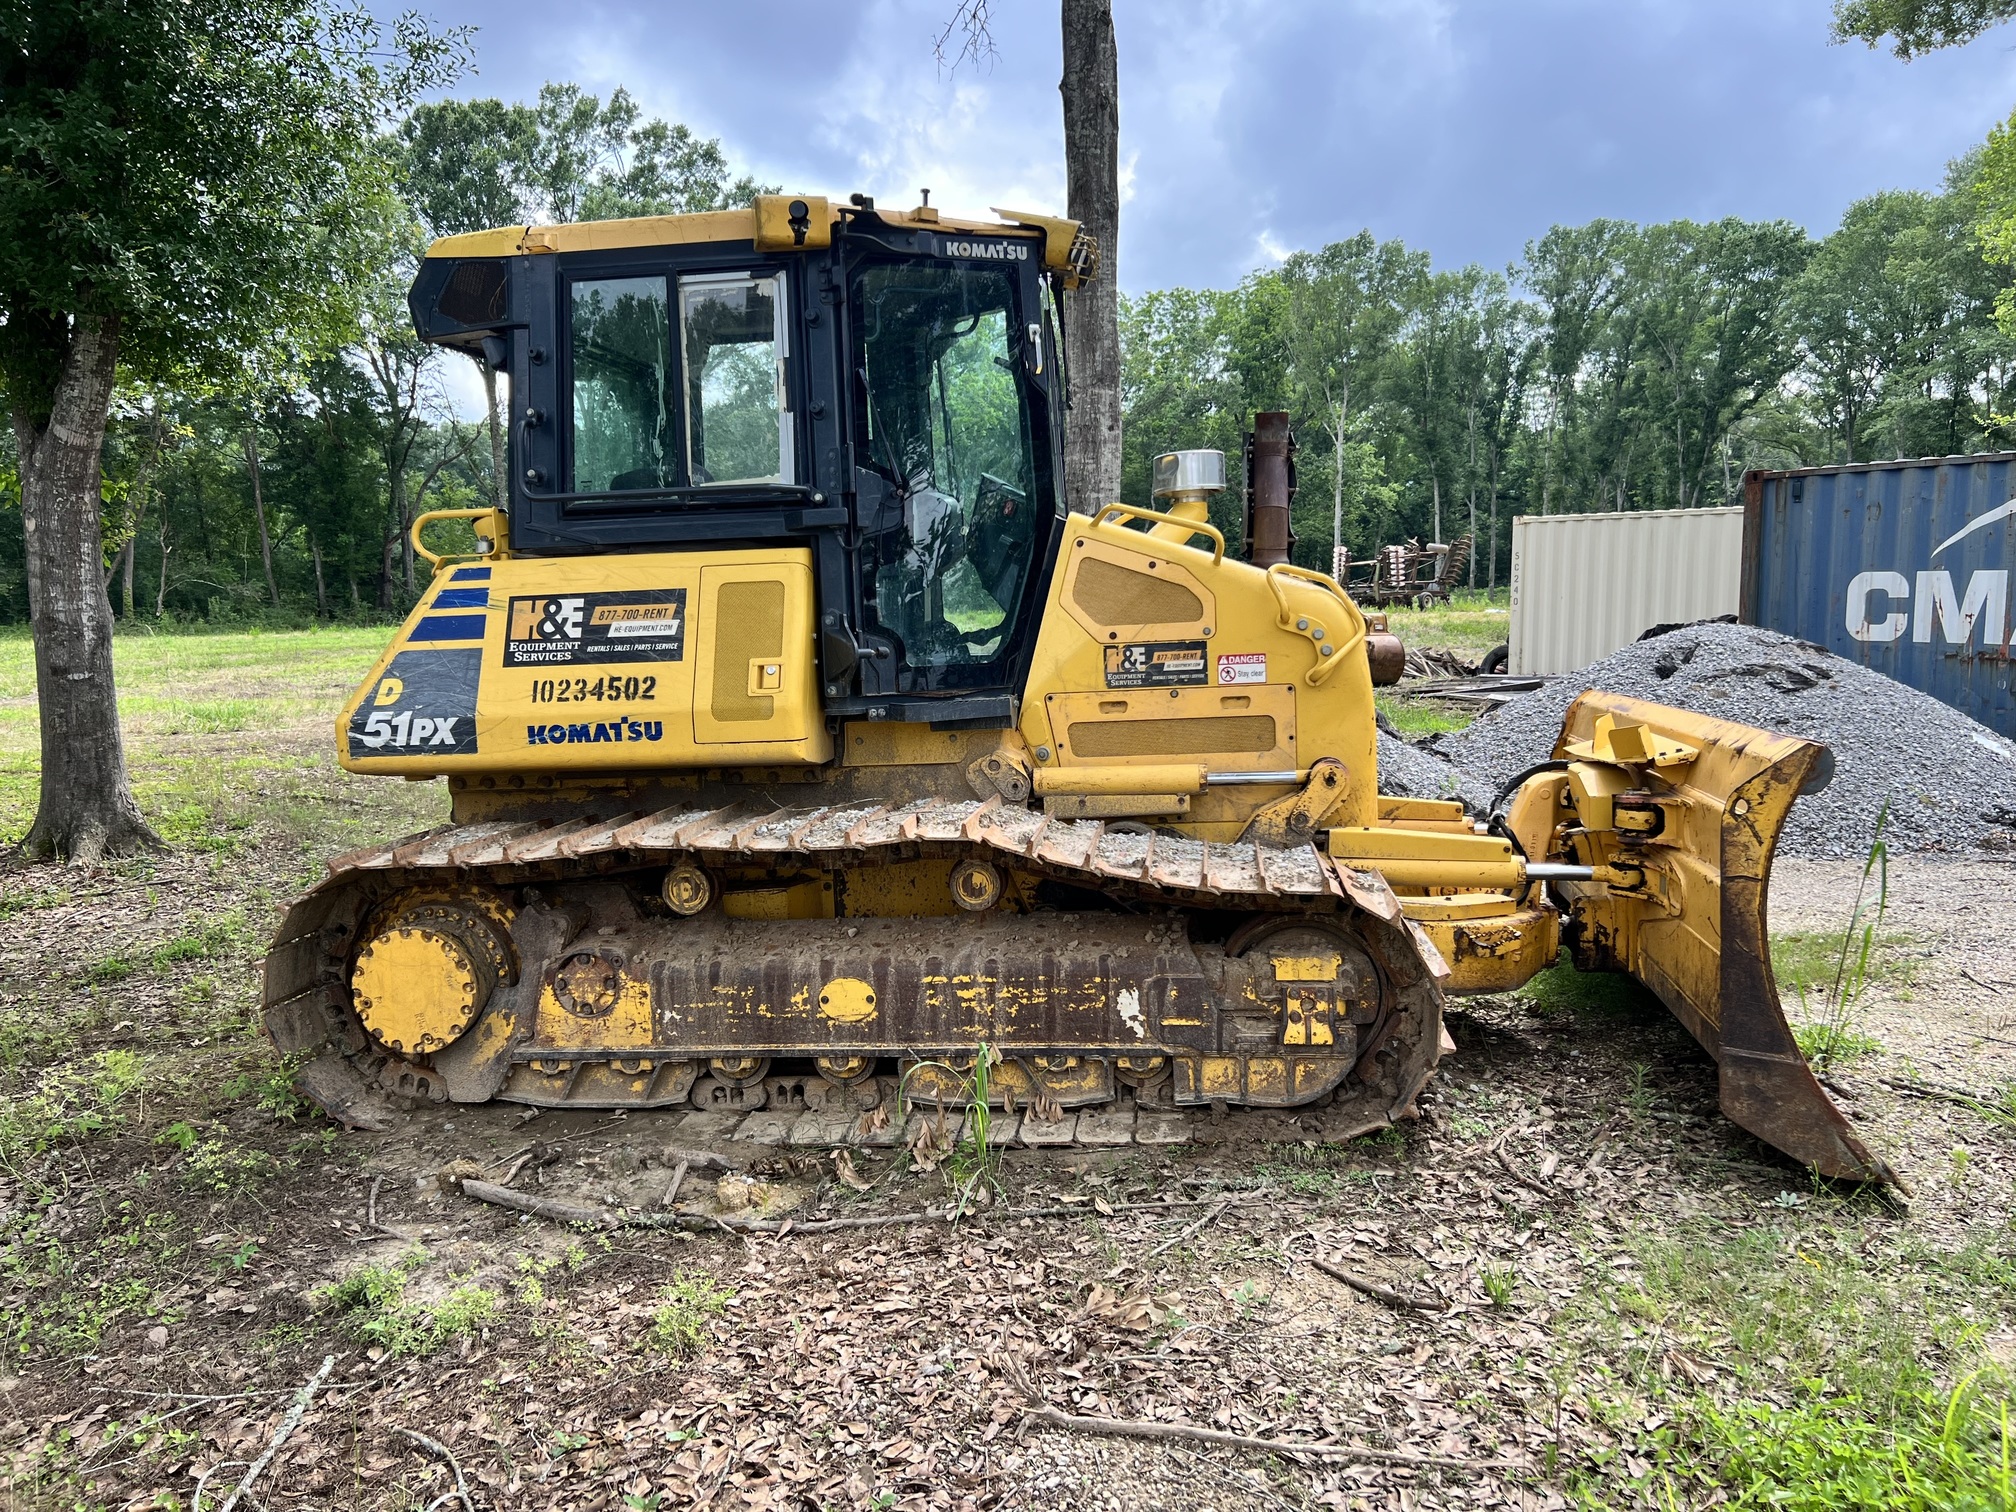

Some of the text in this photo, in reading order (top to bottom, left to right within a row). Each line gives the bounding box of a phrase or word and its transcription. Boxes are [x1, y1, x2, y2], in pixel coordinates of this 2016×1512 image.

[946, 241, 1028, 260] KOMATSU
[598, 607, 669, 621] 877-700-RENT
[1845, 569, 2016, 645] CM
[510, 598, 585, 640] H&E
[509, 641, 581, 652] EQUIPMENT
[586, 642, 679, 653] RENTALS SALES PARTS SERVICE
[513, 651, 572, 662] SERVICES
[1228, 655, 1265, 664] DANGER
[1237, 670, 1250, 678] Stay
[373, 678, 404, 706] D
[532, 676, 657, 703] 10234502
[362, 710, 459, 748] 51PX
[527, 716, 663, 745] KOMATSU
